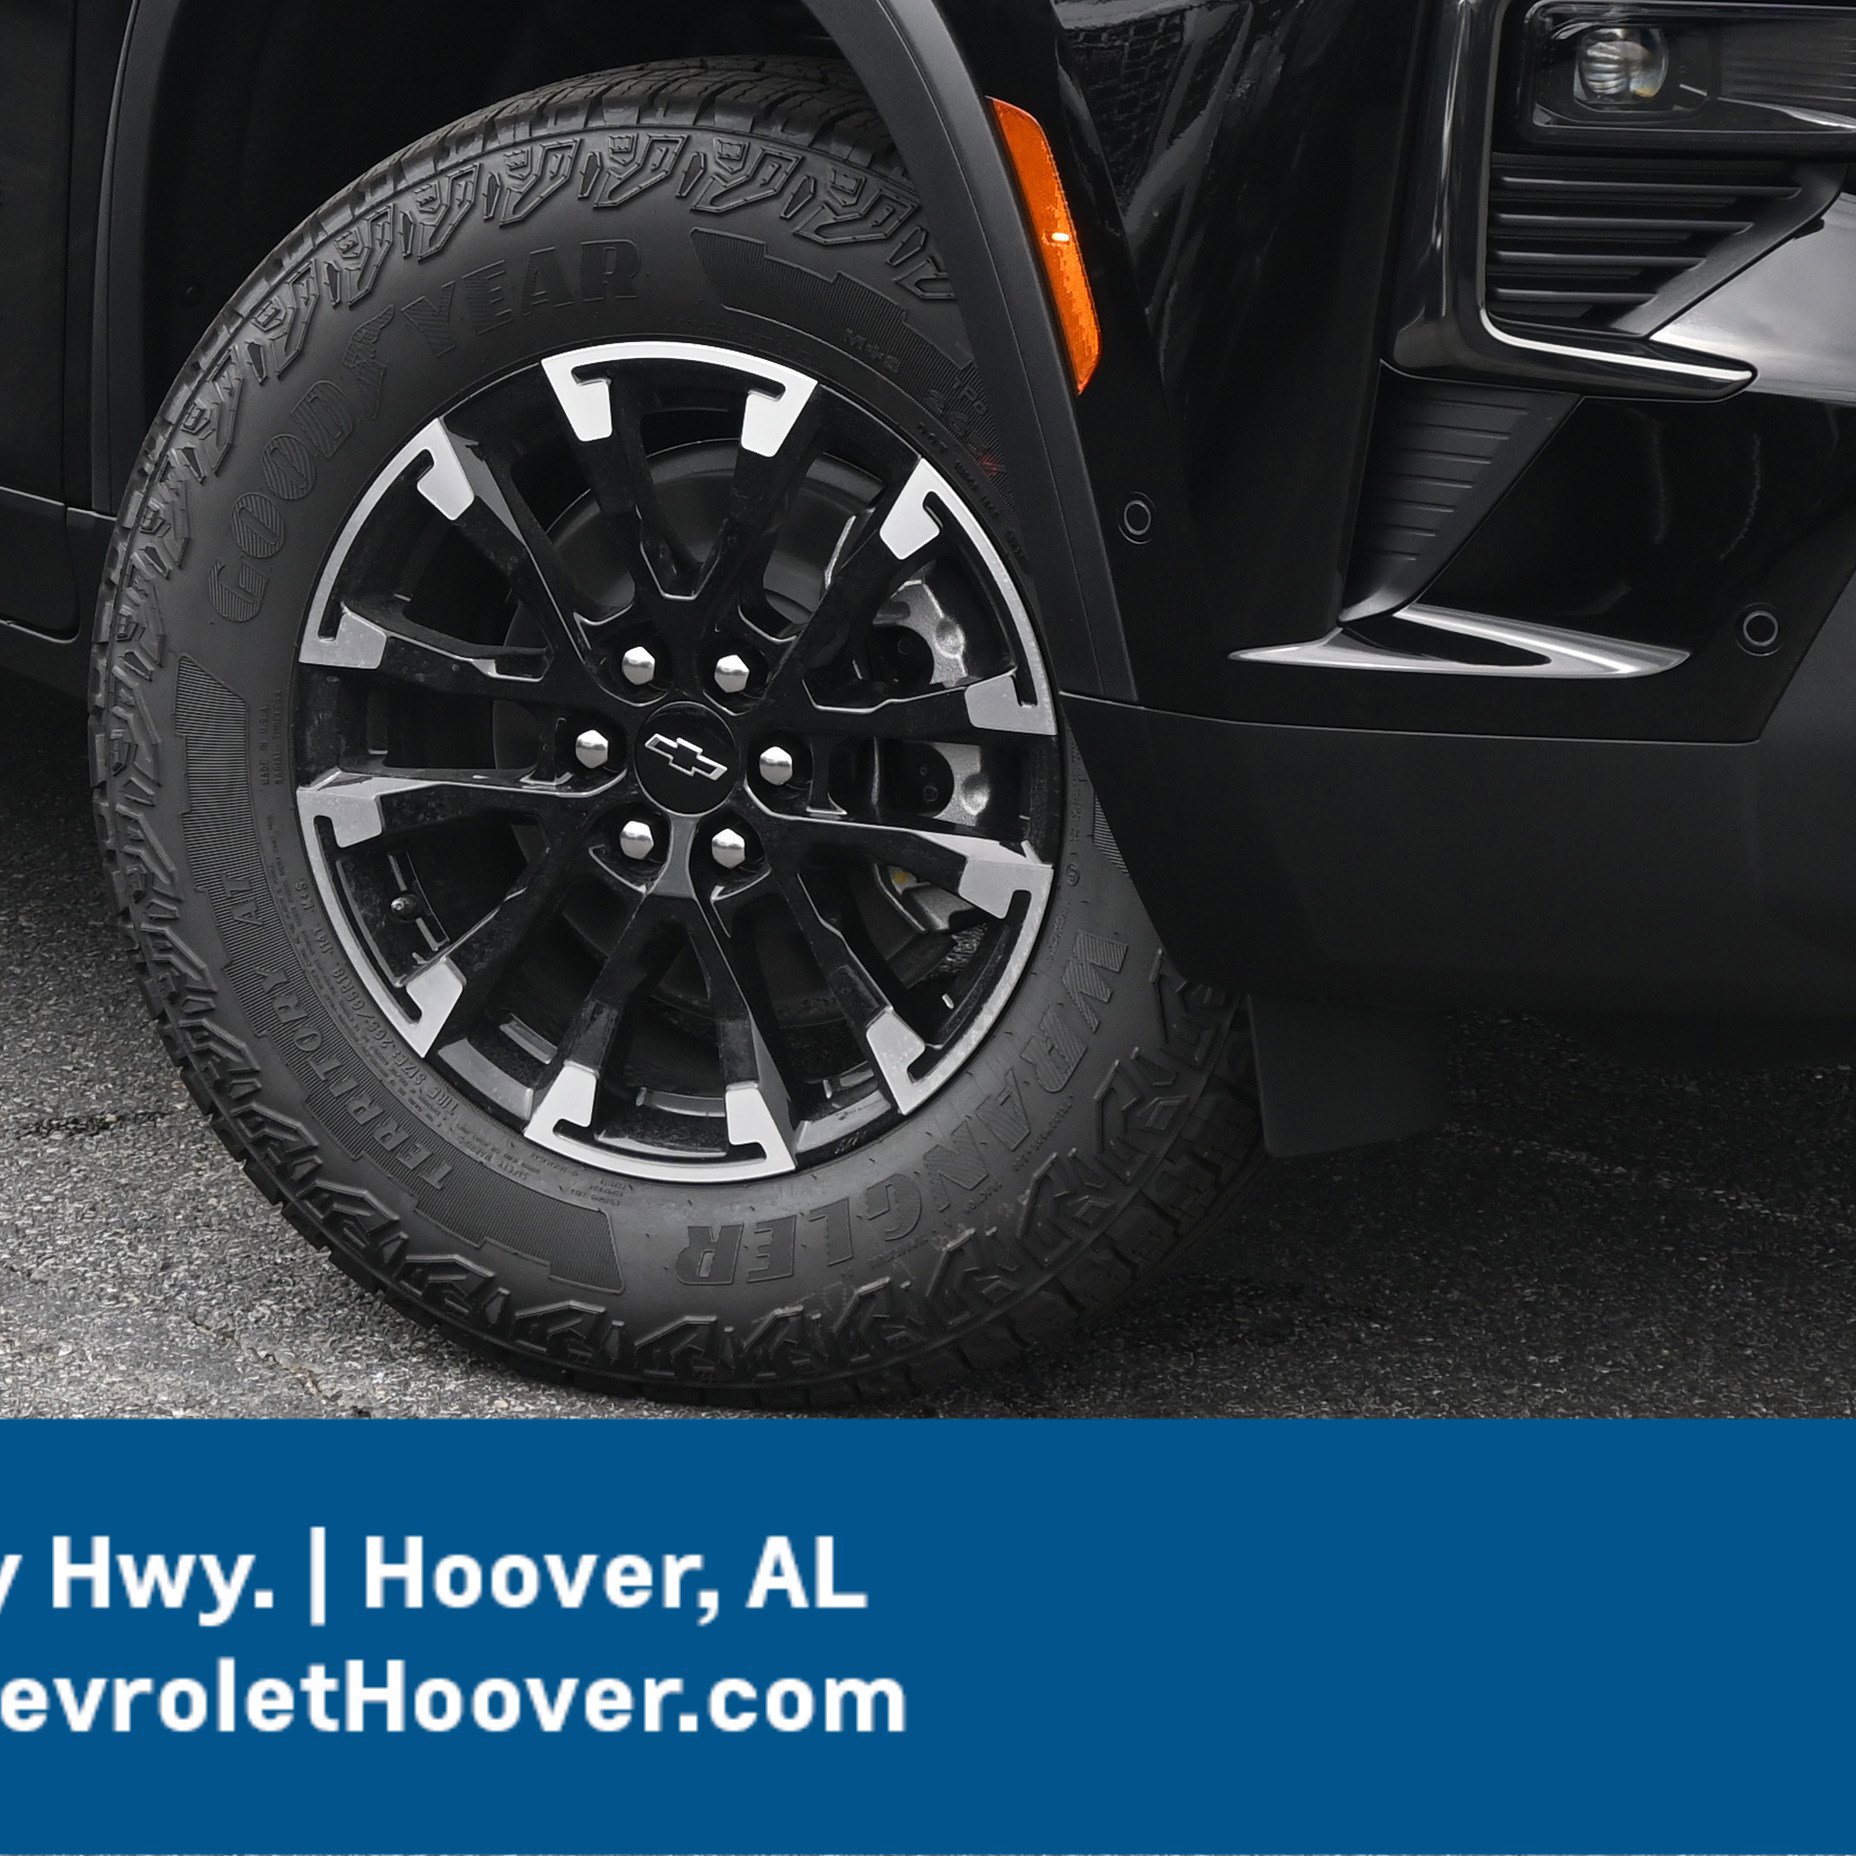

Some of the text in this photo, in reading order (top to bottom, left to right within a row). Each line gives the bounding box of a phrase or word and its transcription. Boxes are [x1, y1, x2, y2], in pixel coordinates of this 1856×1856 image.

[219, 872, 264, 927] AT
[252, 965, 454, 1191] TERRITORY
[676, 930, 1130, 1288] WRANGLER
